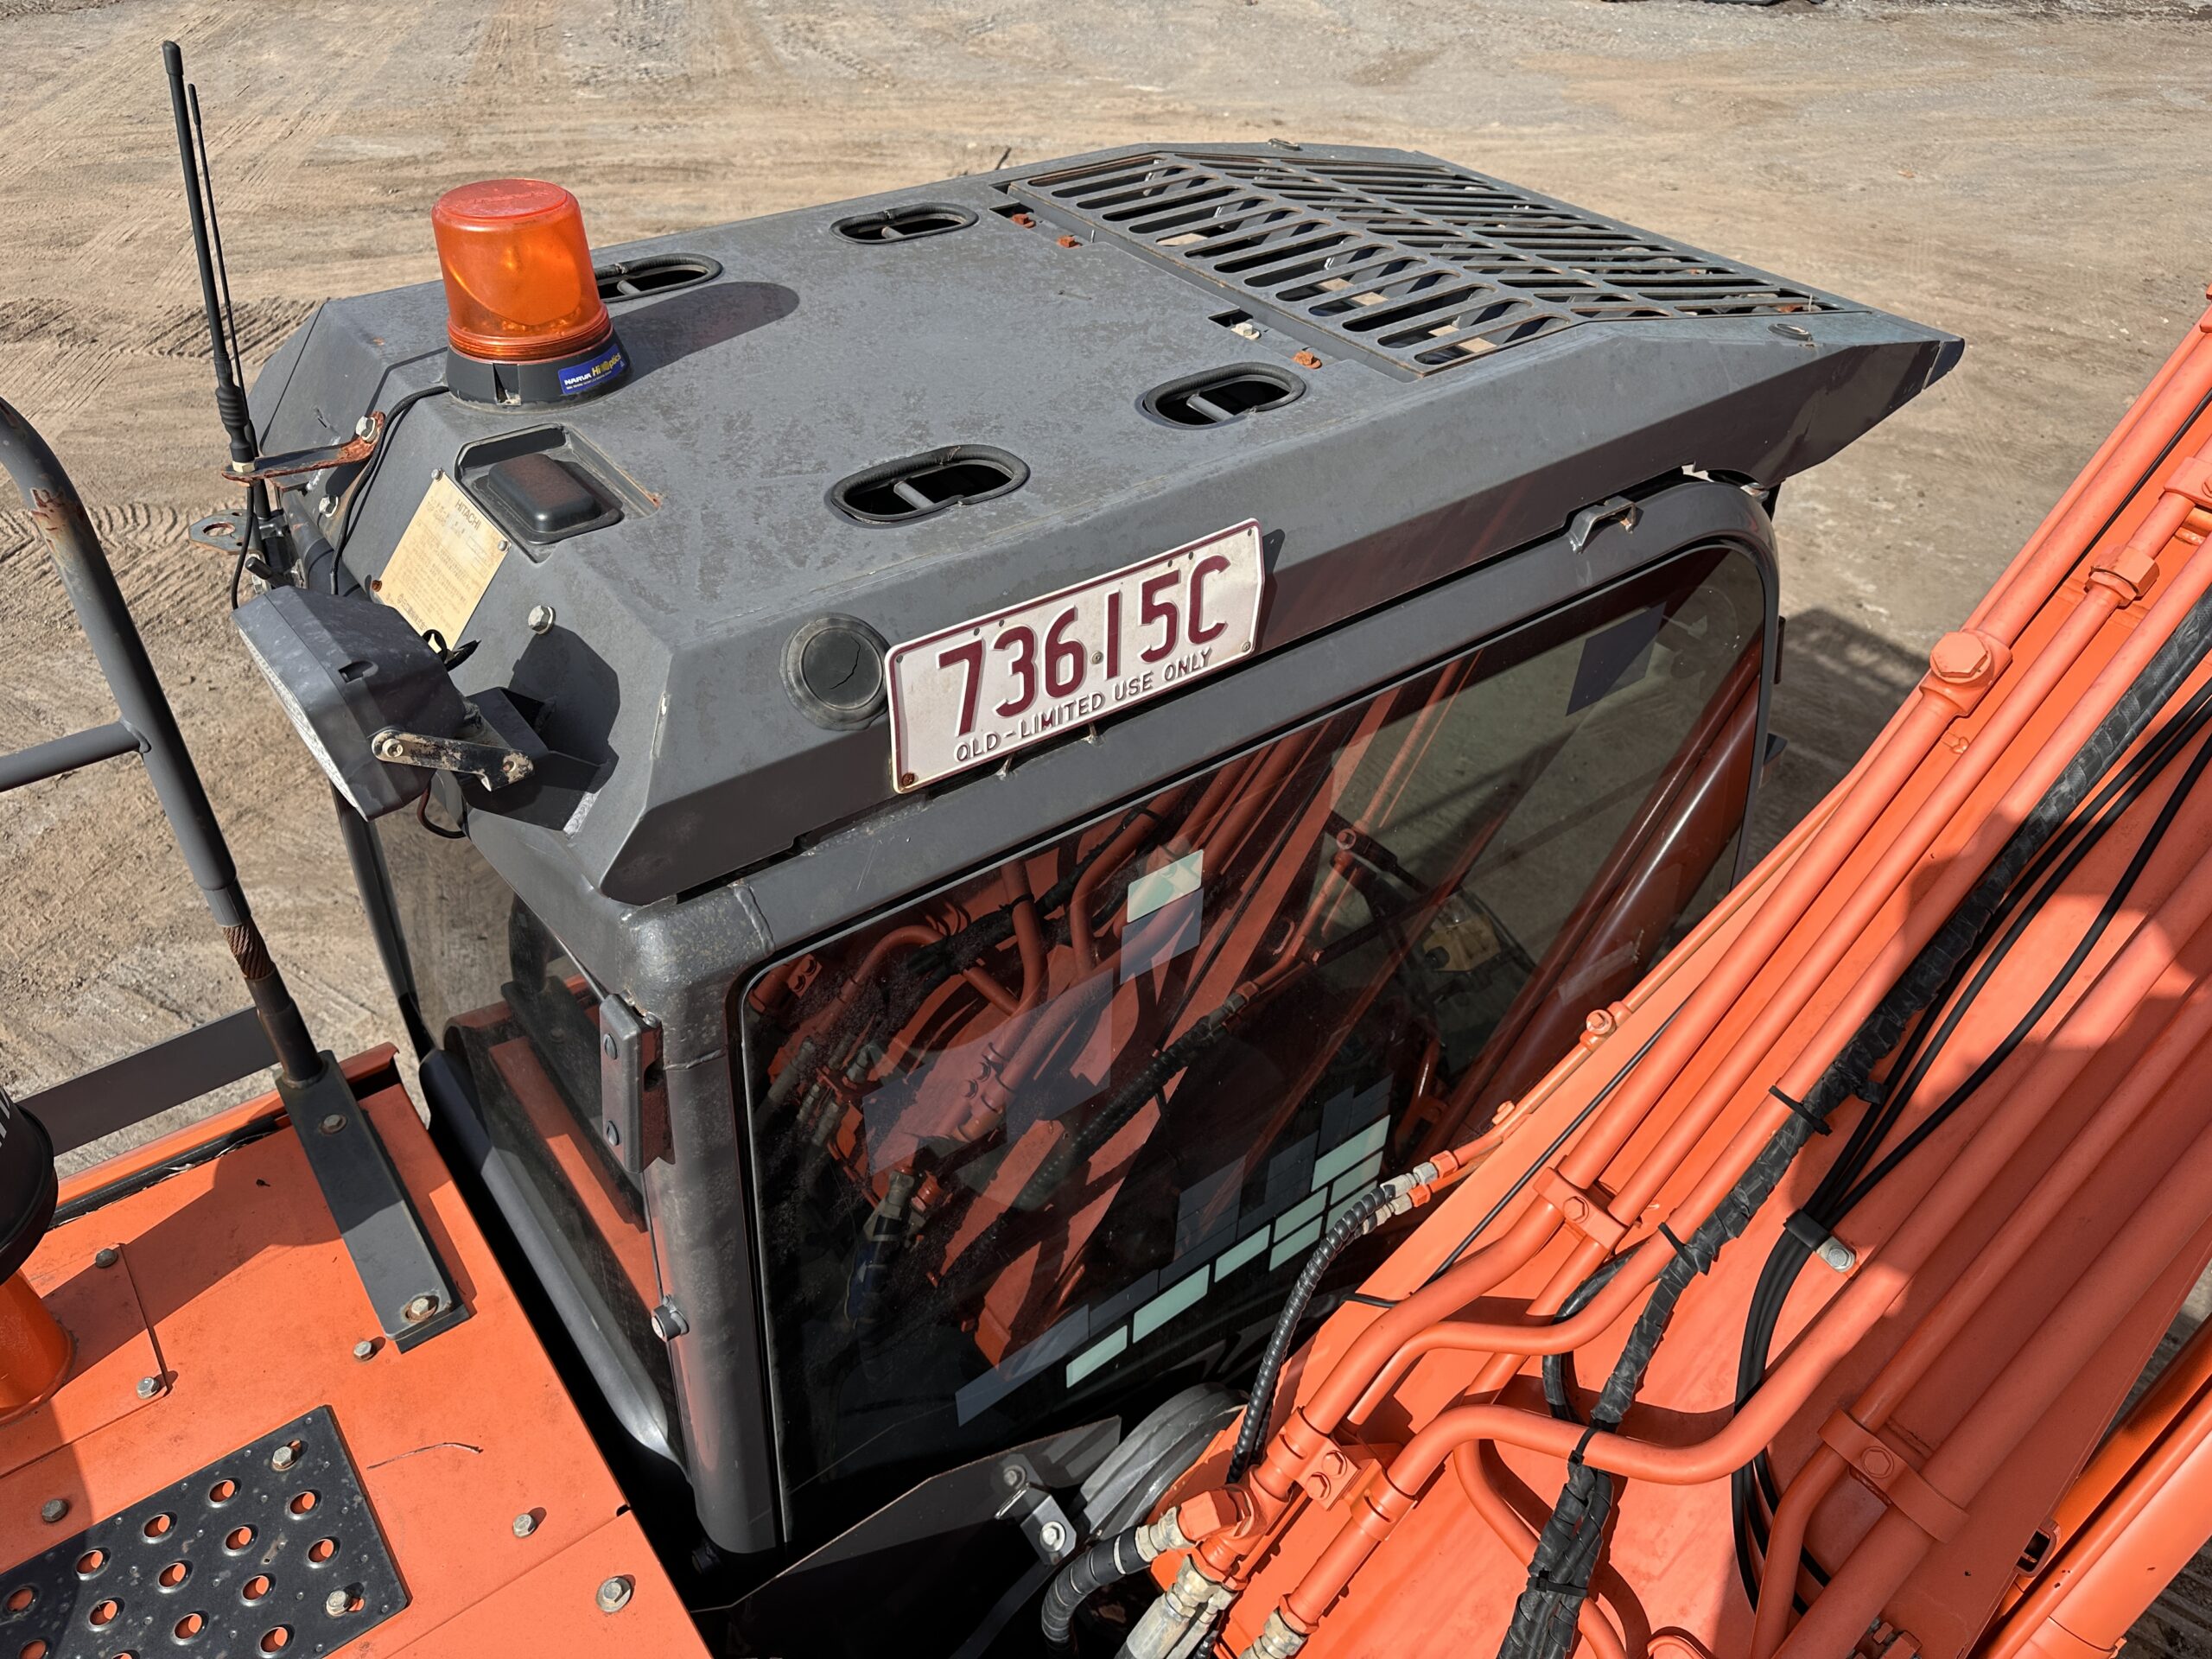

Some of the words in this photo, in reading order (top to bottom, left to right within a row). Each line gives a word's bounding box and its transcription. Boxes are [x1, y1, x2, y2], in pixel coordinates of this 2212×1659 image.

[564, 372, 592, 385] NARVA
[454, 499, 480, 531] HITACHI
[1114, 671, 1153, 702] USE
[1163, 647, 1211, 682] ONLY
